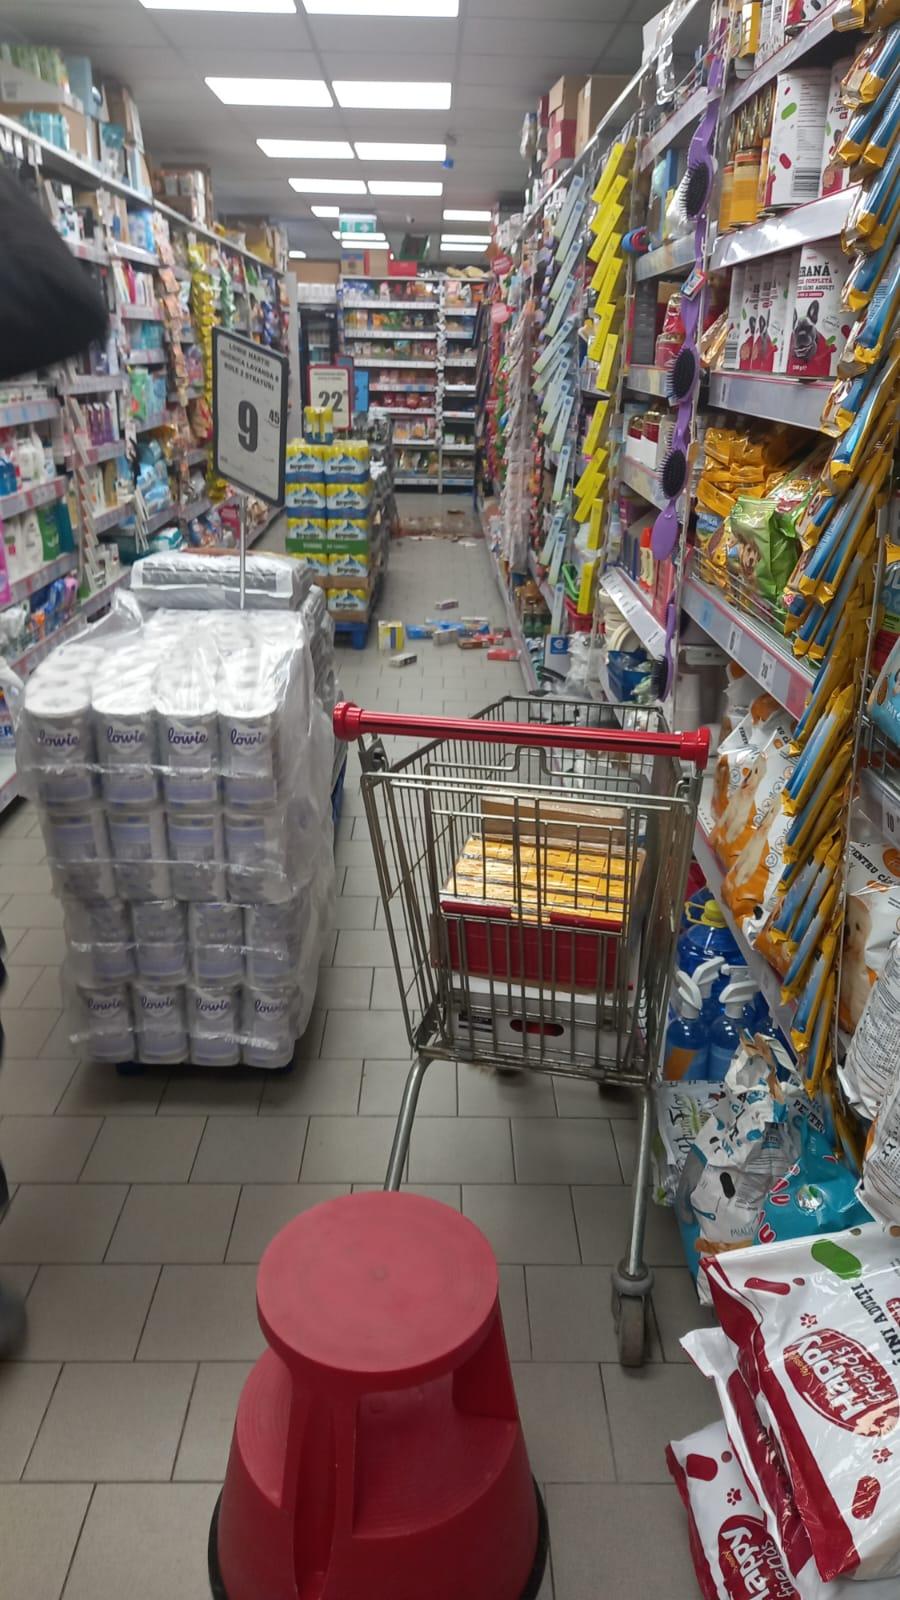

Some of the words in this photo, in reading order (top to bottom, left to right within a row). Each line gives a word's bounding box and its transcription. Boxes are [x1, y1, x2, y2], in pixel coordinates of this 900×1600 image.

[318, 391, 343, 412] 22
[238, 400, 258, 453] 9
[268, 408, 280, 425] 45
[106, 726, 145, 743] lowie
[168, 727, 208, 744] lowie
[196, 998, 230, 1011] lowie
[850, 1282, 889, 1324] ADULȚI
[797, 1335, 868, 1421] Happy
[833, 1346, 894, 1406] friends
[721, 1527, 770, 1600] appy
